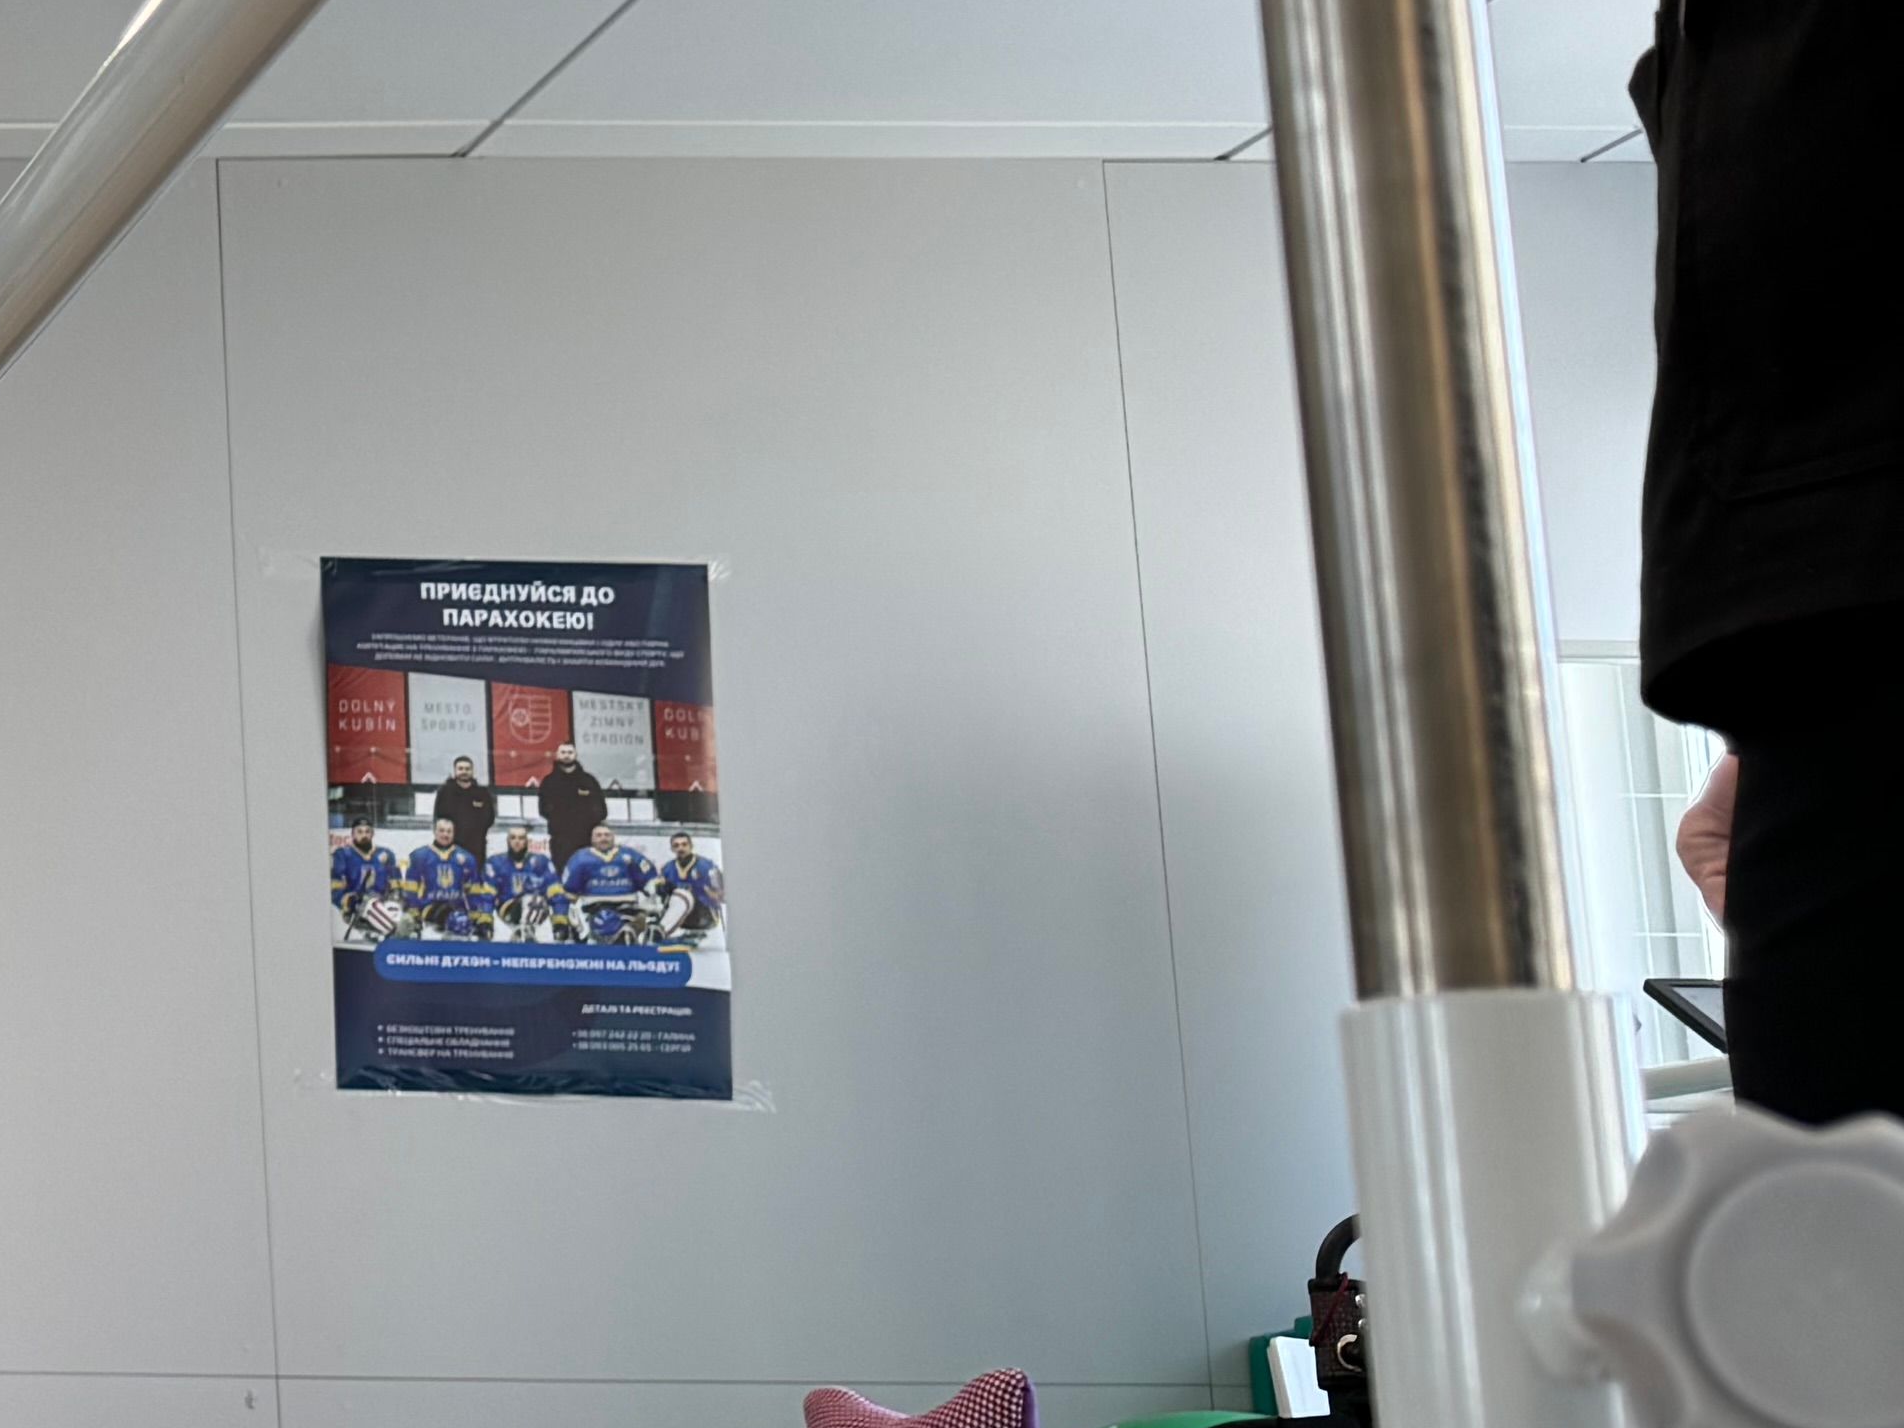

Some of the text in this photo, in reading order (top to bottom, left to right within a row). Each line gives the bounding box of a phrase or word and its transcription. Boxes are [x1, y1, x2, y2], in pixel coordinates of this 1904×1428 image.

[420, 581, 616, 606] ПРИЄДНУЙСЯ ДО
[442, 608, 594, 631] ПАРАХОКЕЮ!
[386, 953, 439, 967] СИЛЬНІ
[441, 955, 491, 968] ДУХОМ
[501, 957, 605, 971] НЕПЕРЕМОЖНІ
[606, 959, 626, 971] НА
